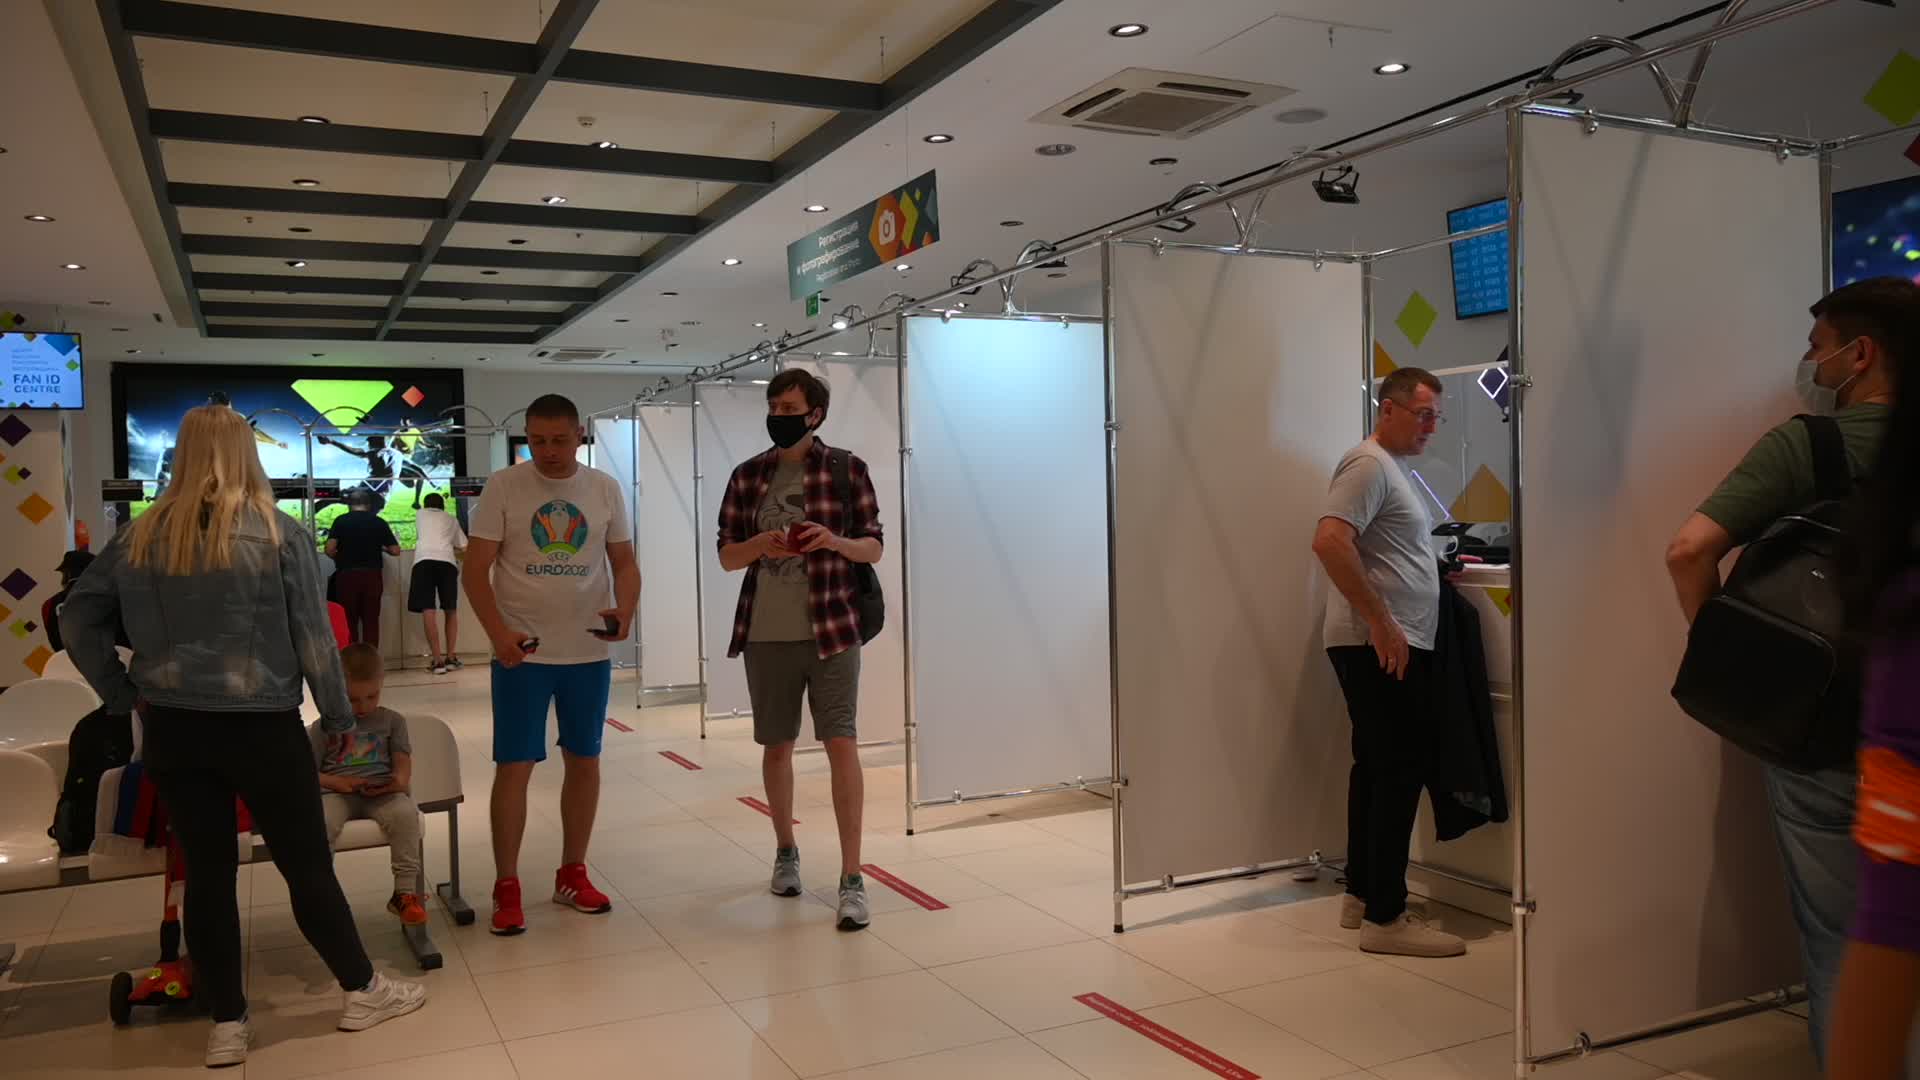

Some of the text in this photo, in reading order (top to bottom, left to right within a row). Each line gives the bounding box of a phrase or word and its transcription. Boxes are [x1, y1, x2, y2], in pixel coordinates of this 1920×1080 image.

[13, 374, 61, 385] FAN ID
[14, 385, 61, 394] CENTRE
